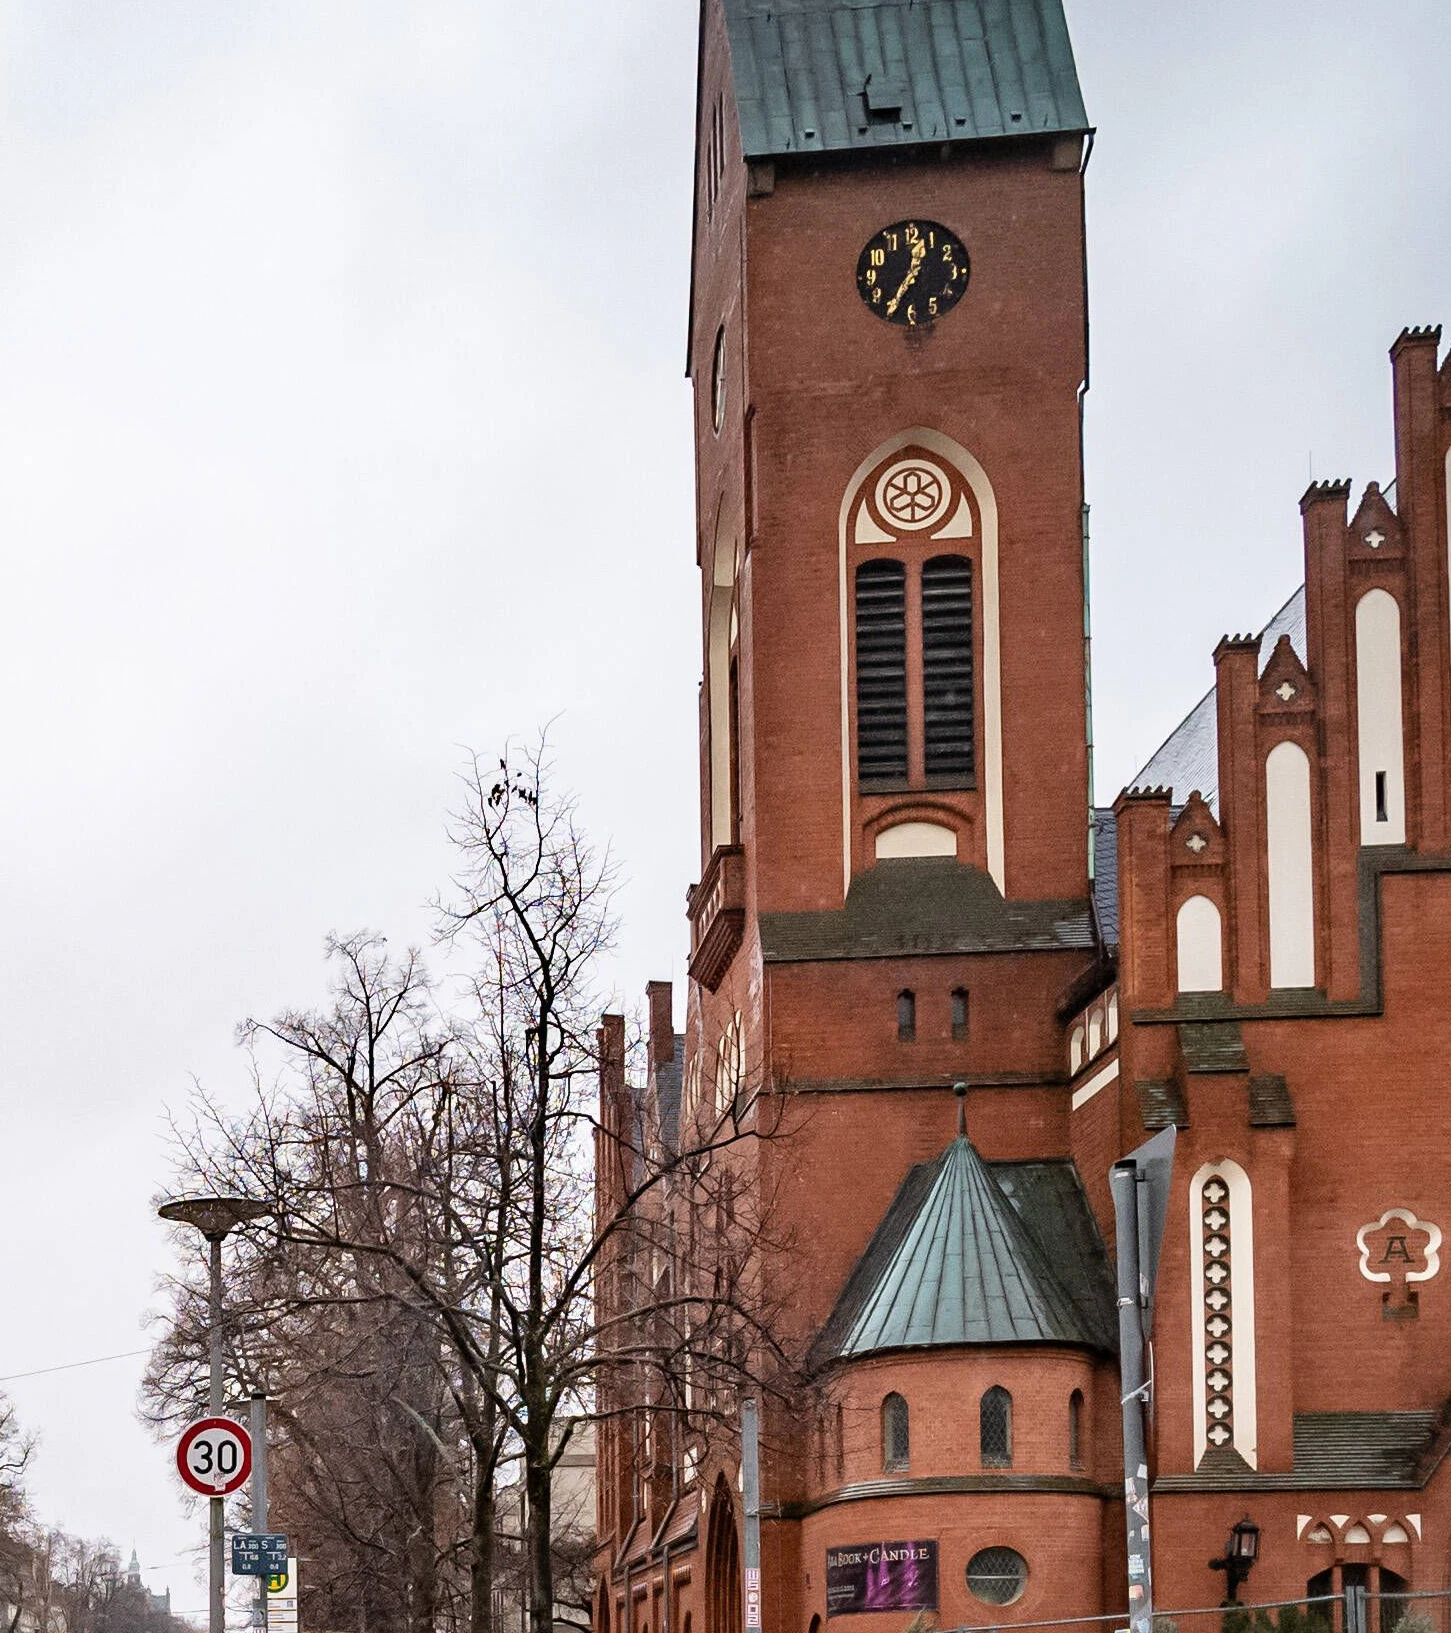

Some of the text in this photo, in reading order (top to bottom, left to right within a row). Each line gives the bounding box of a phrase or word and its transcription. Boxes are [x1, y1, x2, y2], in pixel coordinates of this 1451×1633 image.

[904, 227, 919, 244] 12
[929, 231, 935, 248] 1
[870, 249, 885, 266] 10
[942, 244, 952, 262] 2
[866, 269, 876, 286] 9
[928, 297, 937, 315] 5
[193, 1440, 238, 1475] 30
[838, 1552, 862, 1567] BOOK
[869, 1548, 930, 1564] CANDLE
